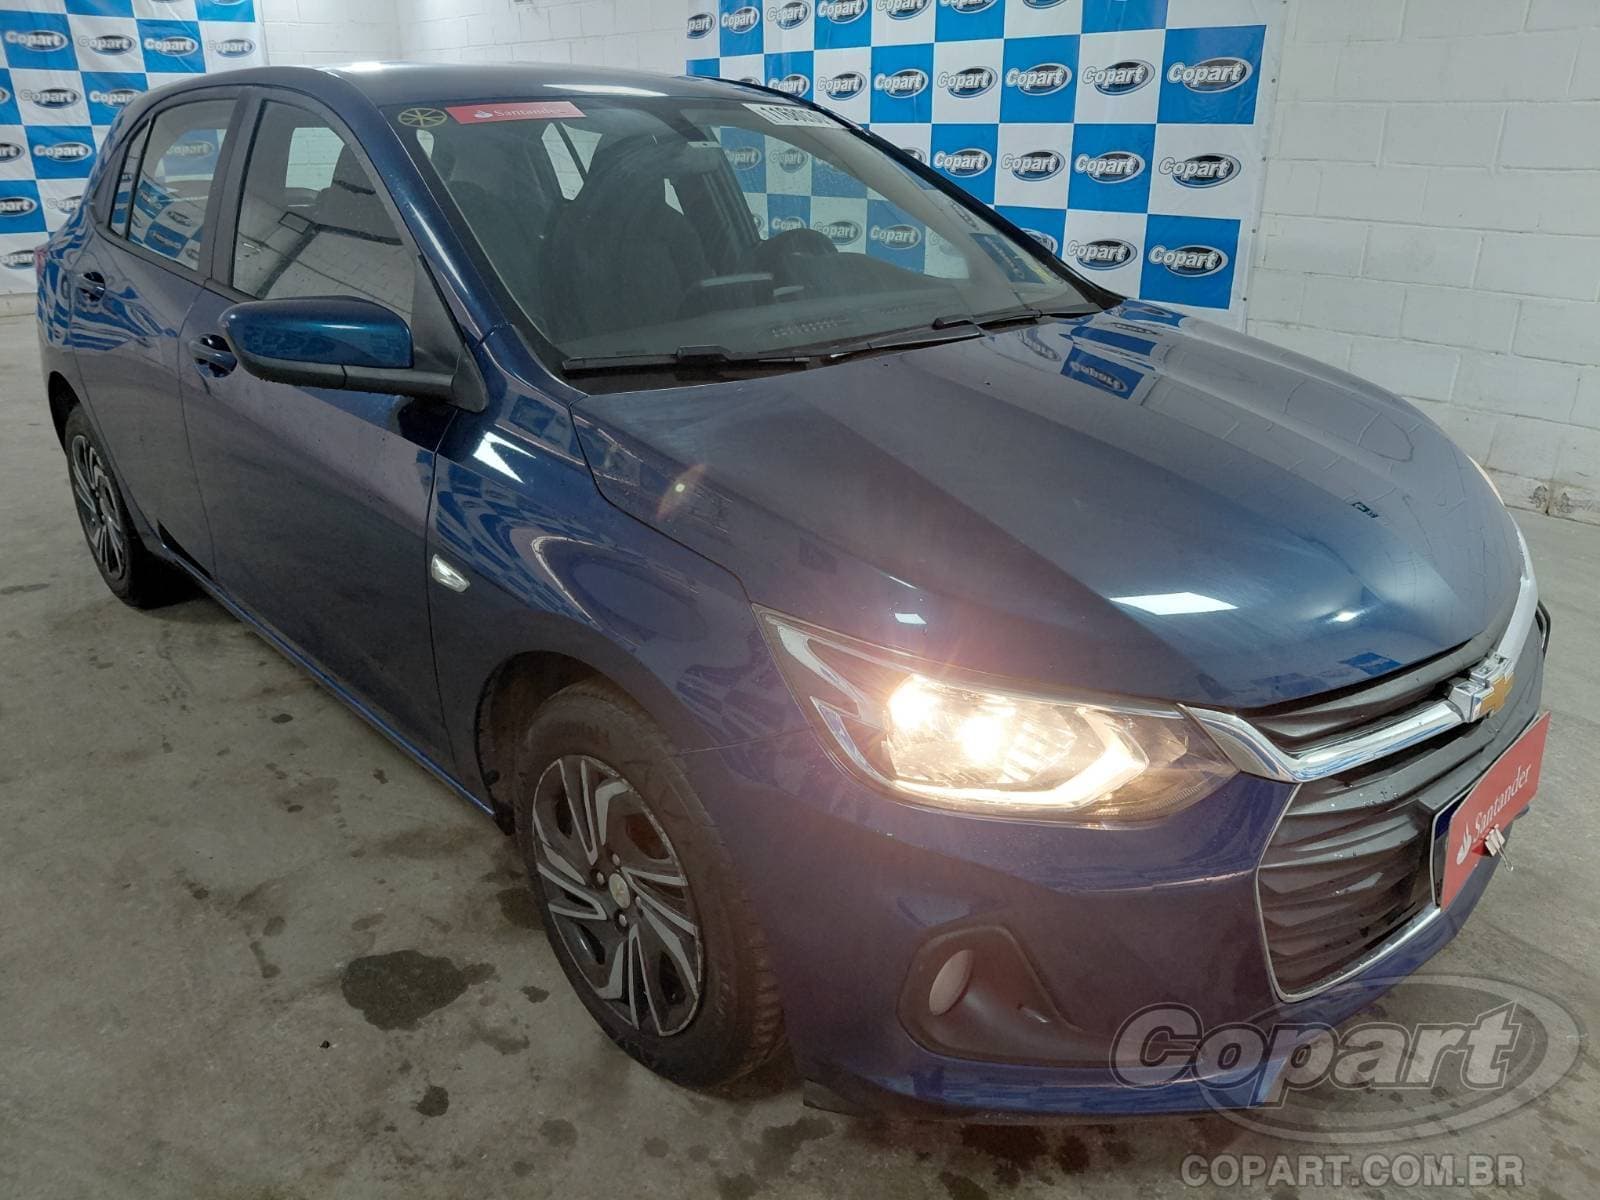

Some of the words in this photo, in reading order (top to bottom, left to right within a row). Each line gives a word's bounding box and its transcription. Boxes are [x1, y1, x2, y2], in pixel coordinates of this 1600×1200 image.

[767, 2, 804, 21] Copart
[817, 0, 864, 17] Copart
[687, 17, 711, 31] part
[721, 9, 755, 29] Copart
[5, 31, 61, 47] Copart
[79, 35, 130, 50] Copart
[144, 38, 192, 52] Copart
[207, 40, 252, 54] Copart
[816, 73, 862, 95] Copart
[874, 71, 922, 91] Copart
[937, 69, 991, 93] Copart
[1005, 67, 1068, 91] Copart
[1082, 66, 1147, 91] Copart
[1166, 62, 1250, 87] Copart
[20, 89, 74, 103] Copart
[90, 91, 136, 105] Copar
[33, 145, 87, 159] Copart
[769, 150, 803, 166] Copart
[934, 152, 987, 172] Copart
[1001, 153, 1057, 175] Copart
[1073, 154, 1139, 178] Copart
[1158, 156, 1234, 179] Copart
[0, 199, 30, 212] part
[47, 198, 80, 211] Copa
[814, 222, 856, 241] Copart
[871, 225, 917, 244] Copart
[0, 254, 34, 267] opar
[1067, 240, 1132, 263] Copart
[1149, 246, 1222, 270] Copart
[1472, 764, 1532, 843] Santander
